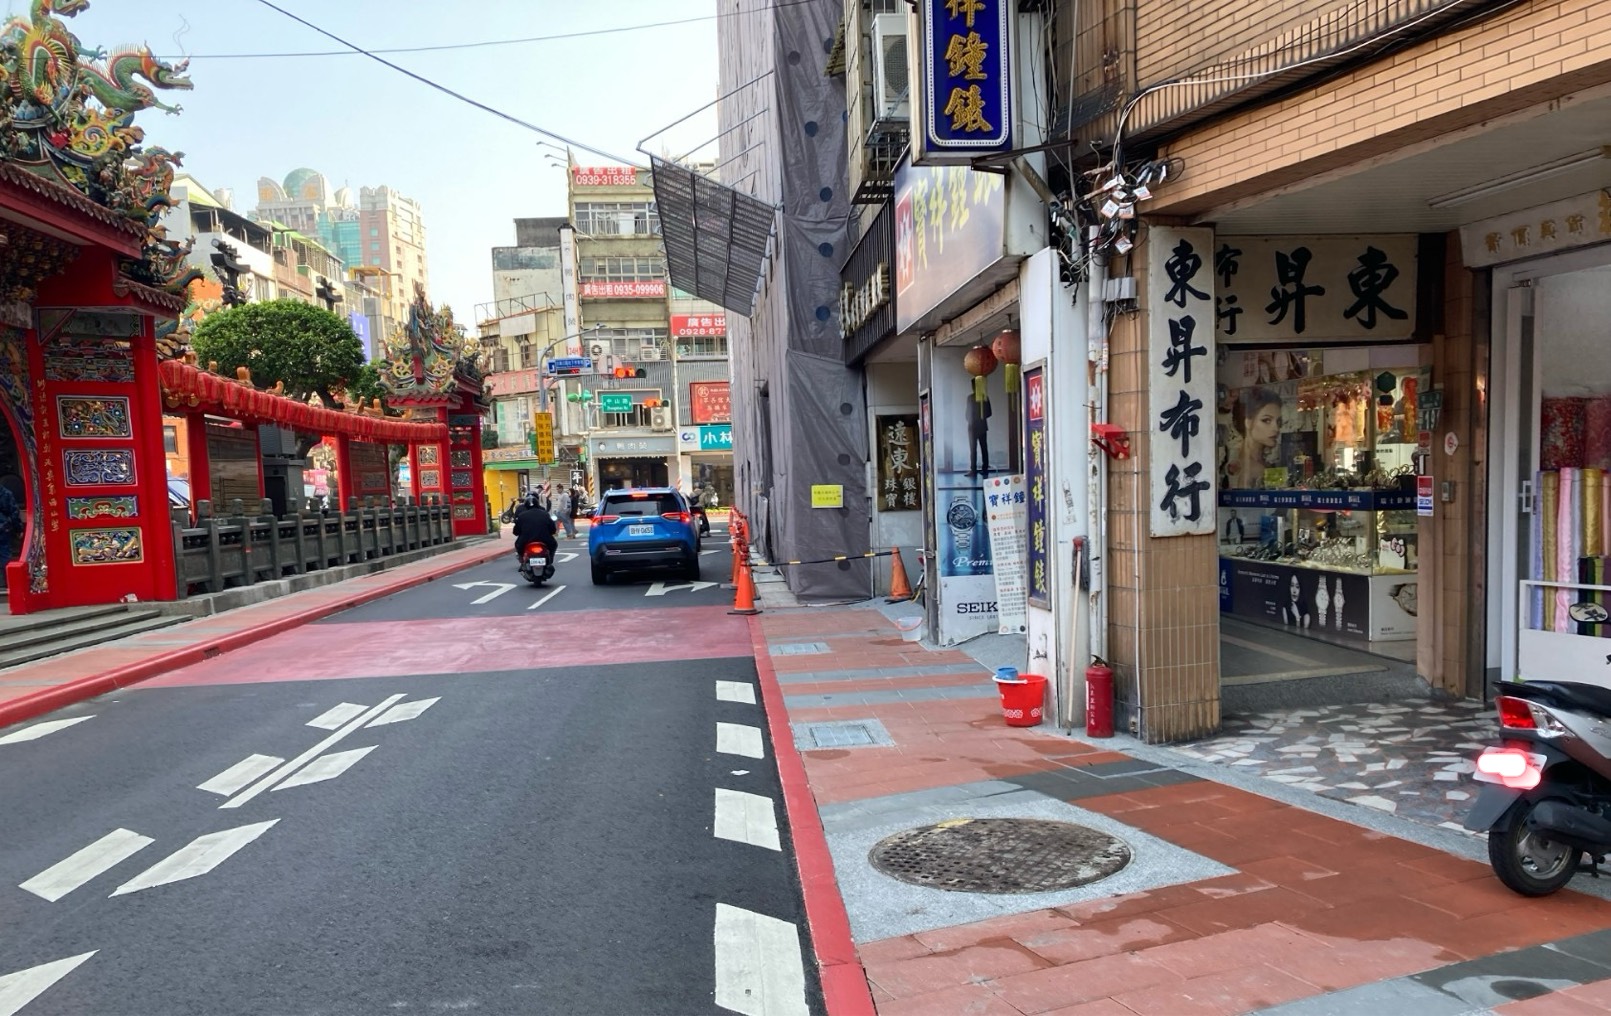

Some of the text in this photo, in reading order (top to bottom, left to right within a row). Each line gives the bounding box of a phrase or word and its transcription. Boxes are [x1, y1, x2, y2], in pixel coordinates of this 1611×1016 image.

[576, 175, 636, 185] 0939-318355
[584, 284, 613, 296] 廣告出租
[1160, 239, 1211, 521] 東昇布行
[702, 431, 733, 445] 小林
[889, 420, 912, 474] 遠東
[885, 477, 898, 508] 珠寶
[903, 477, 917, 506] 銀樓
[989, 491, 1026, 507] 寶祥鐘
